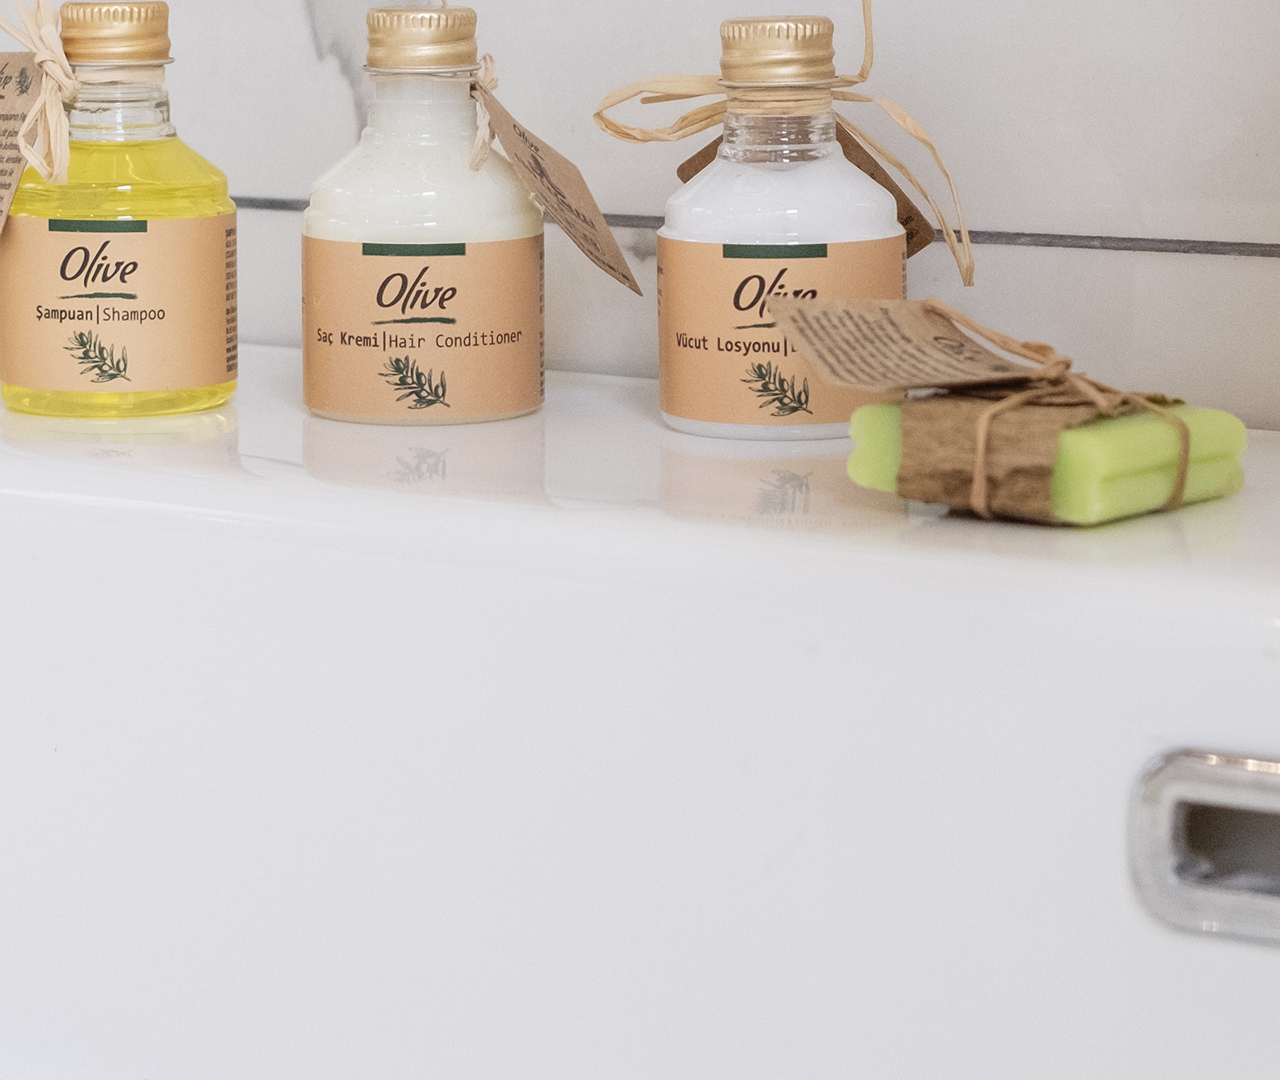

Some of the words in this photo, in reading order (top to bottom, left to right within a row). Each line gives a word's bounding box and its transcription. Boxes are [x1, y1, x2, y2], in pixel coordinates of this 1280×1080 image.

[60, 240, 138, 288] Olive
[376, 266, 457, 314] Olive
[317, 328, 333, 346] Saç
[435, 330, 523, 348] Conditioner
[676, 332, 708, 350] Vücut
